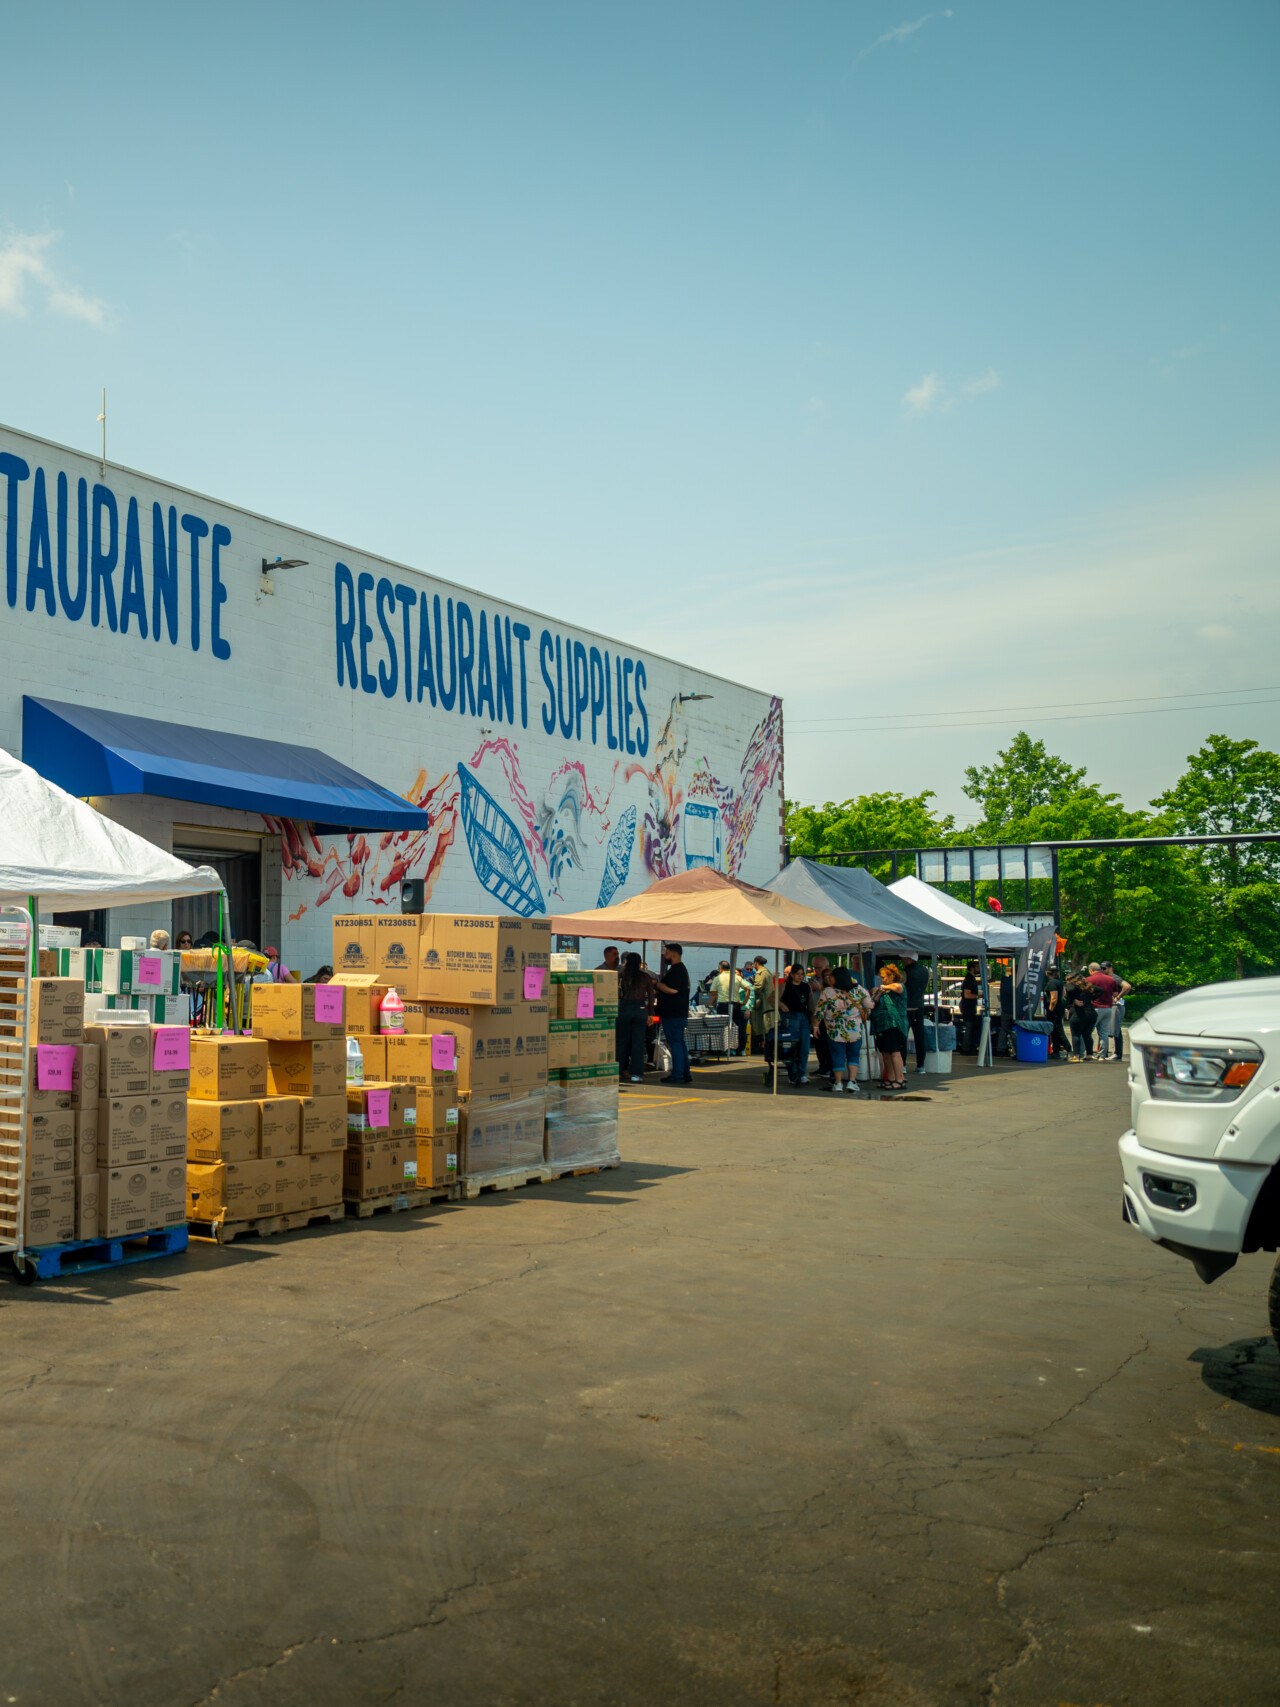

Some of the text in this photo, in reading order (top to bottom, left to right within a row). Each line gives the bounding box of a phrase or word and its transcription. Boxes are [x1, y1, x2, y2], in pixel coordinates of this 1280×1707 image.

[334, 561, 649, 758] RESTAURANT SUPPLIES
[335, 919, 373, 927] KT230851
[378, 919, 417, 927] KT230851
[453, 919, 495, 929] KT230851
[499, 921, 522, 929] KT230851
[446, 950, 465, 959] KITCHEN
[403, 1005, 423, 1014] 0851
[428, 1006, 470, 1016] KT230851
[348, 1024, 365, 1032] BOTTLES
[409, 1075, 426, 1084] BOTTLES
[416, 1127, 430, 1135] TTLES
